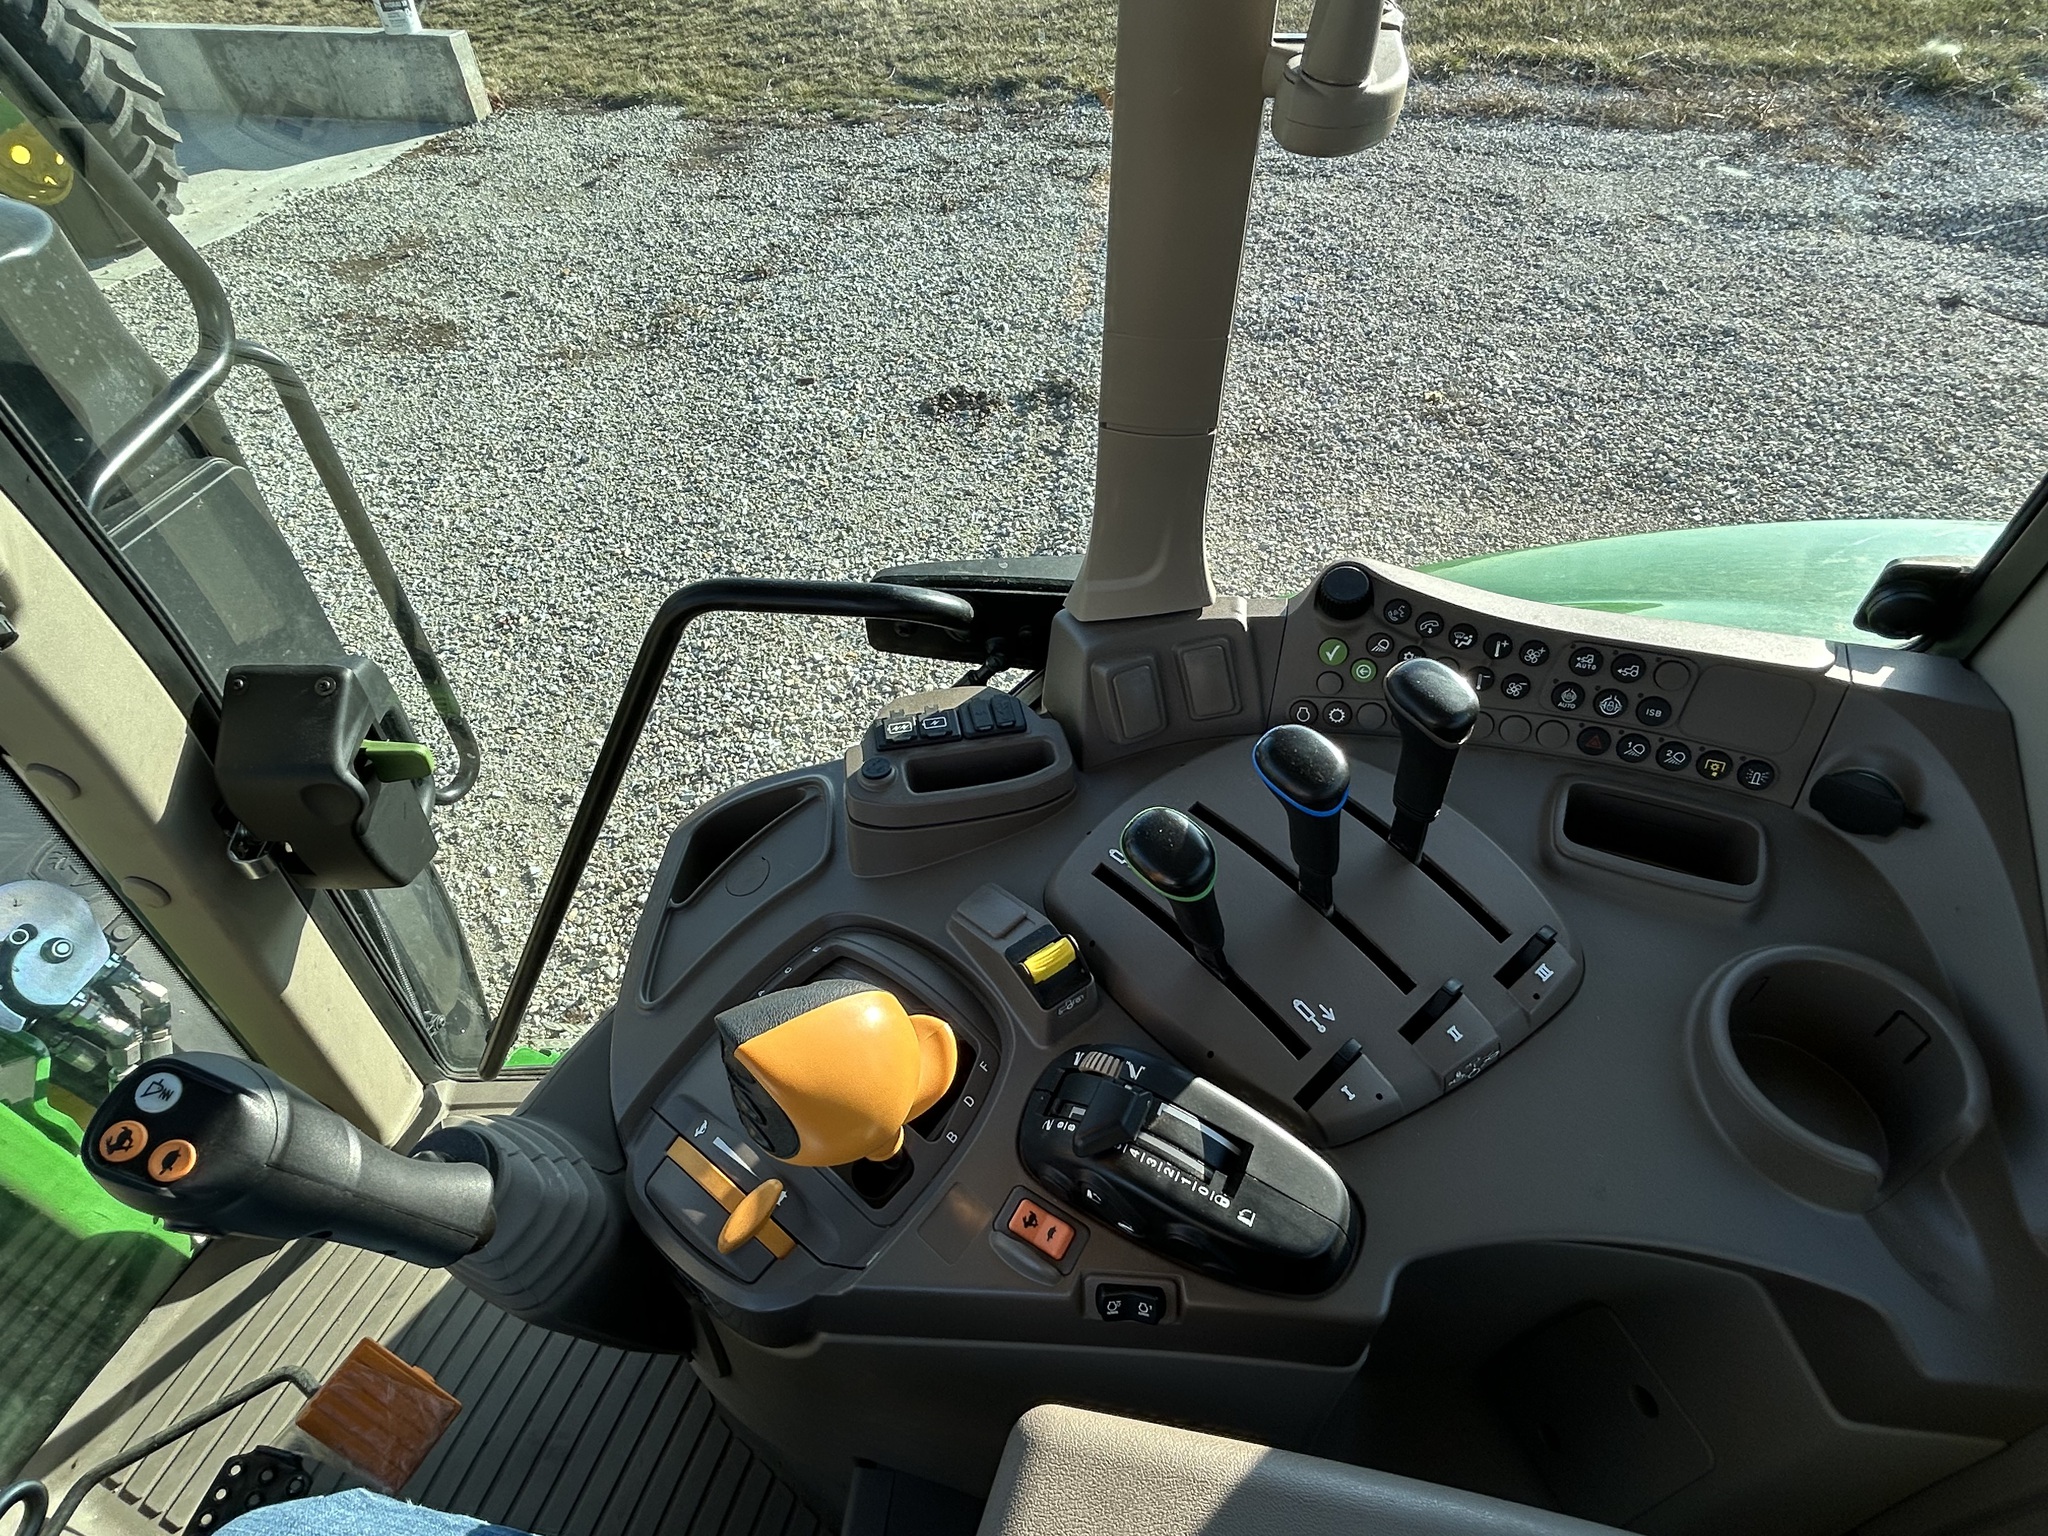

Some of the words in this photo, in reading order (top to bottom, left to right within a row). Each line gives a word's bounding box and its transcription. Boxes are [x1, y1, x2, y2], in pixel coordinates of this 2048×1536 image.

[1575, 661, 1597, 671] AUTO
[1557, 701, 1576, 710] AUTO
[1645, 707, 1662, 718] ISB
[1666, 749, 1673, 757] 2
[979, 1060, 988, 1072] F
[963, 1095, 975, 1108] D
[946, 1131, 958, 1144] B
[1129, 1147, 1140, 1159] 4
[1146, 1158, 1157, 1168] 3
[1163, 1167, 1175, 1178] 2
[1181, 1176, 1192, 1185] 1
[1198, 1185, 1209, 1196] 0
